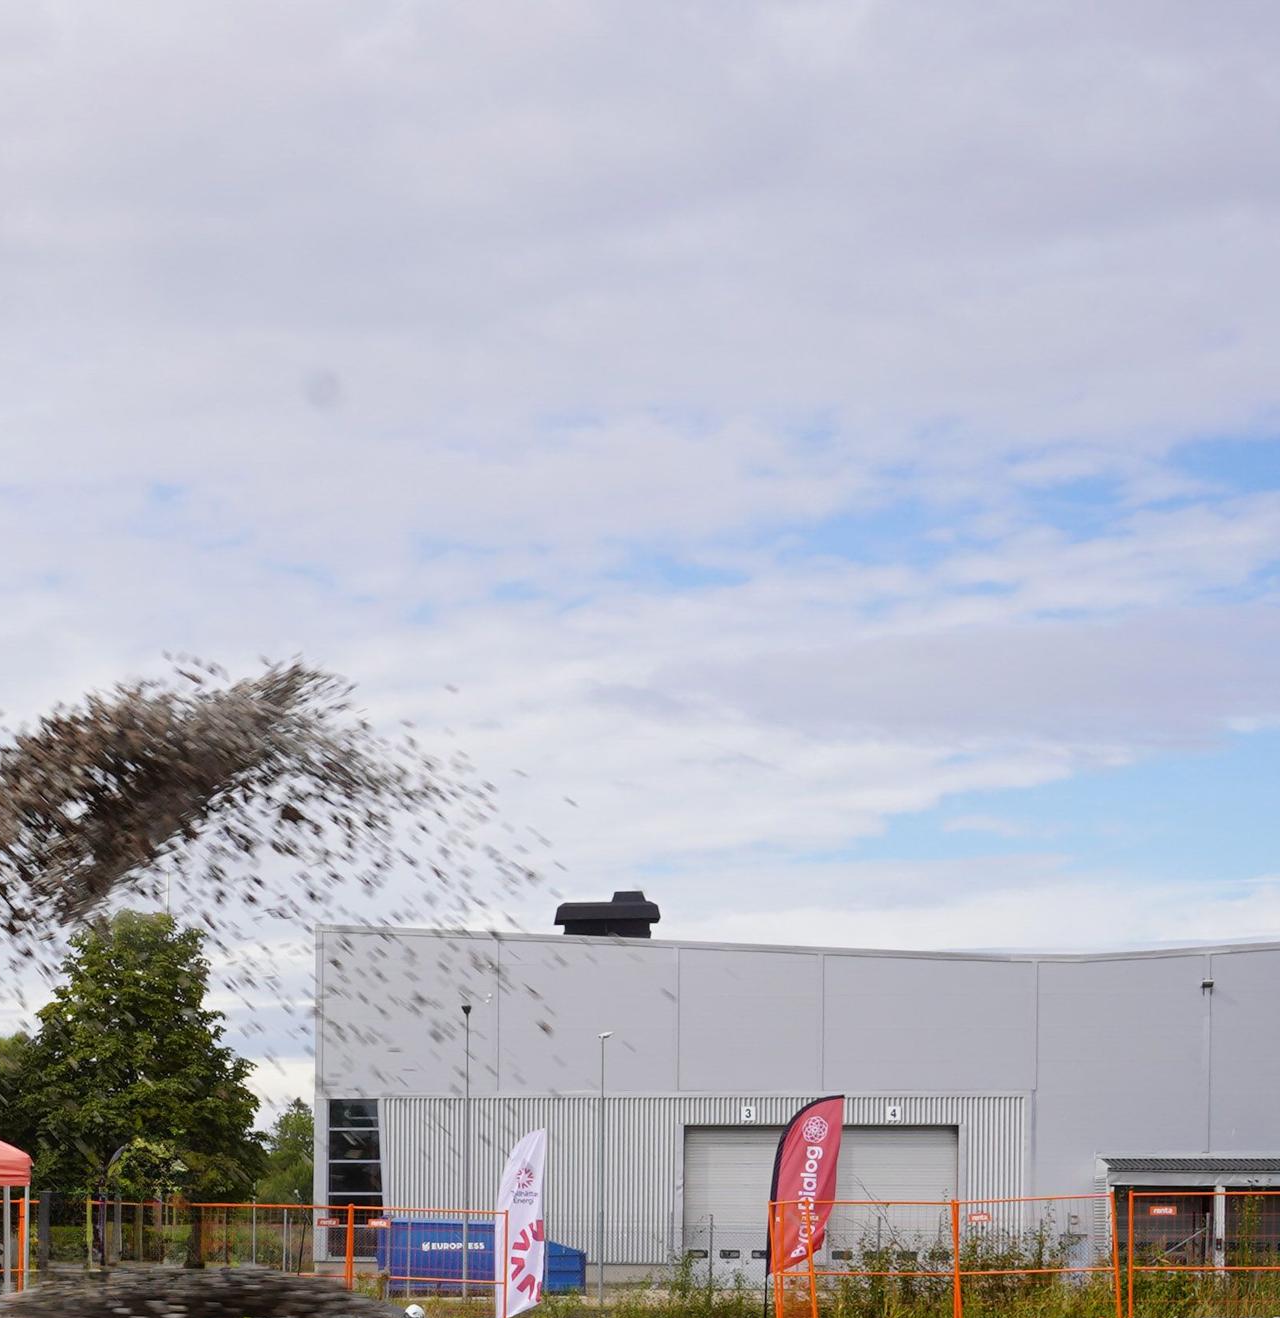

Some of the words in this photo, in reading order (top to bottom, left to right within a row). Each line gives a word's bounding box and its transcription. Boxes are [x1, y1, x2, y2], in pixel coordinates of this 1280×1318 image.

[744, 1108, 752, 1118] 3
[890, 1108, 898, 1118] 4
[431, 1242, 486, 1250] EUROPESS
